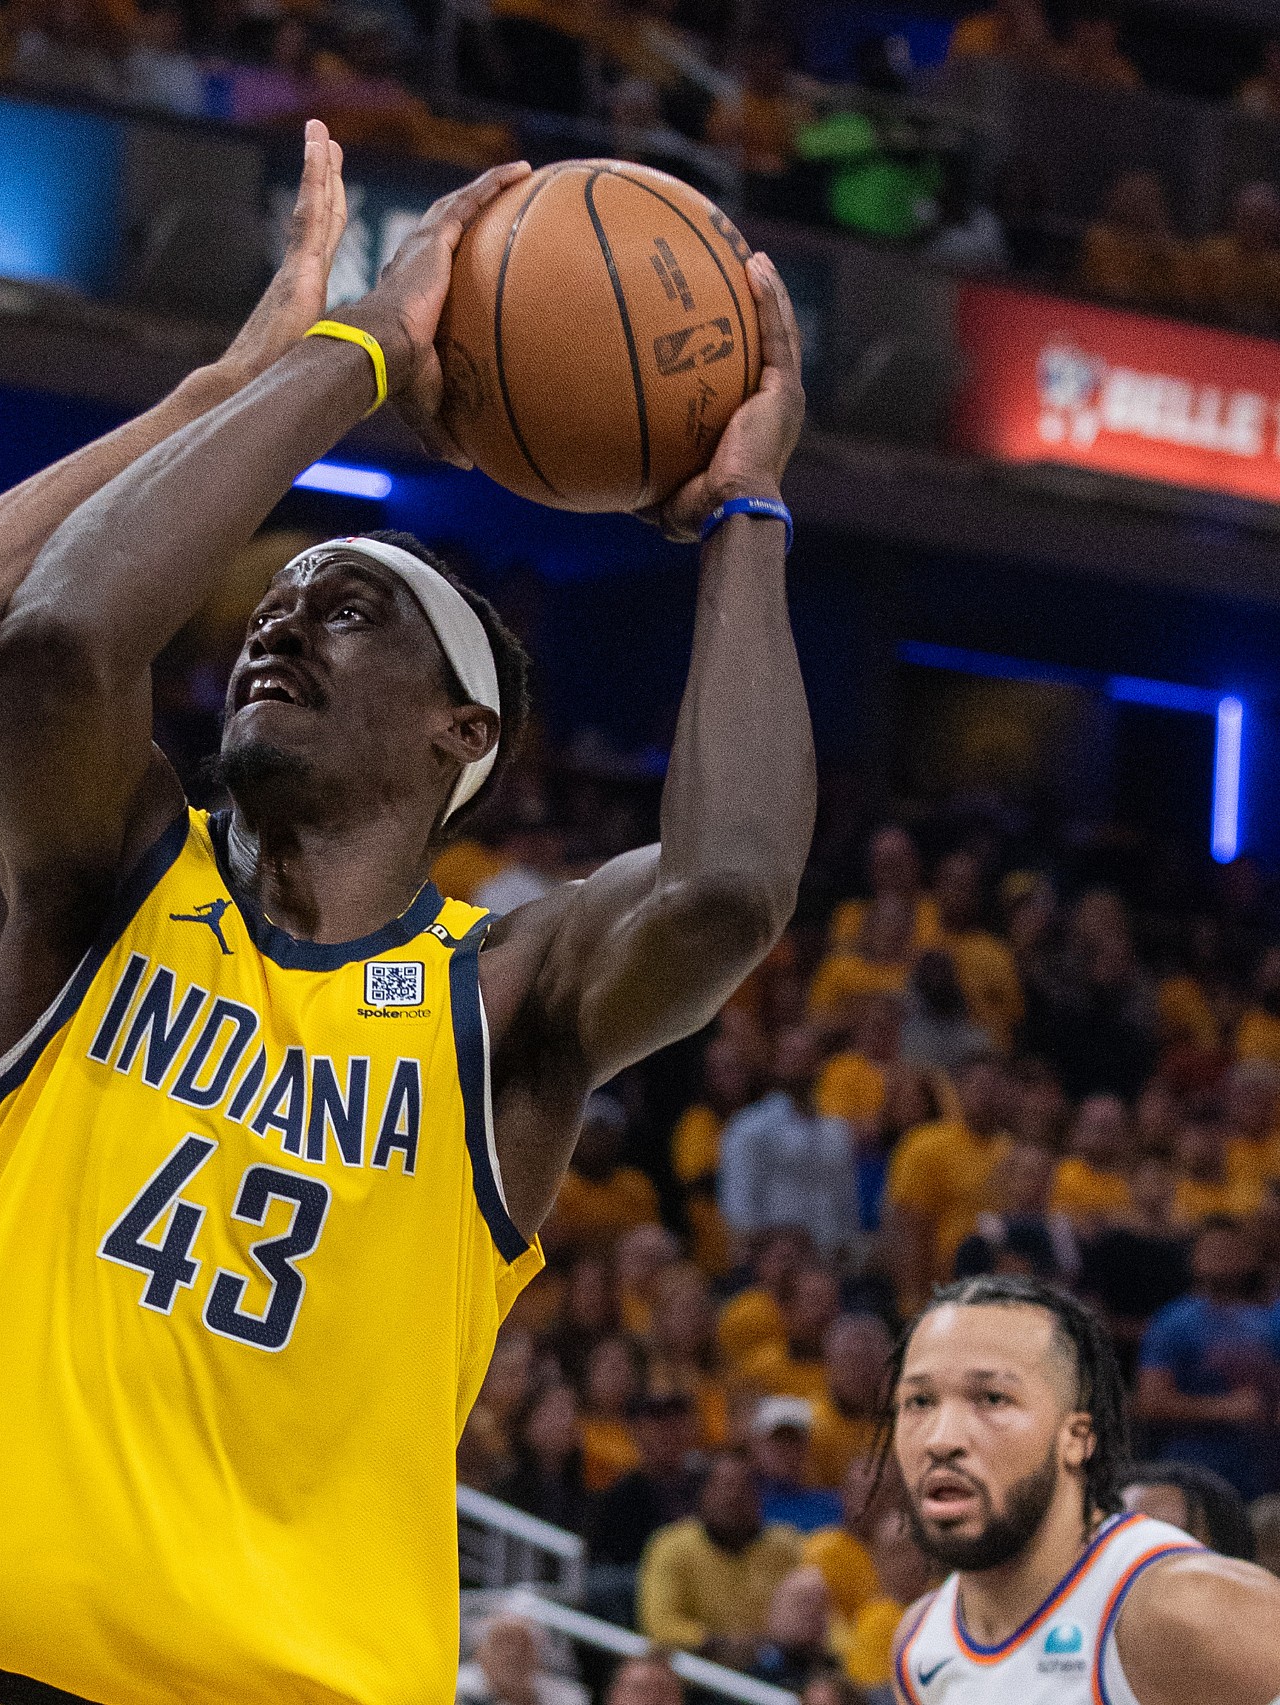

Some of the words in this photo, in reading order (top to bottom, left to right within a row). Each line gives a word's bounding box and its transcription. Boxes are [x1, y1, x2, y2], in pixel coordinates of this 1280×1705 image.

[86, 949, 423, 1177] INDIANA
[357, 1008, 431, 1018] spokenote
[96, 1131, 332, 1353] 43
